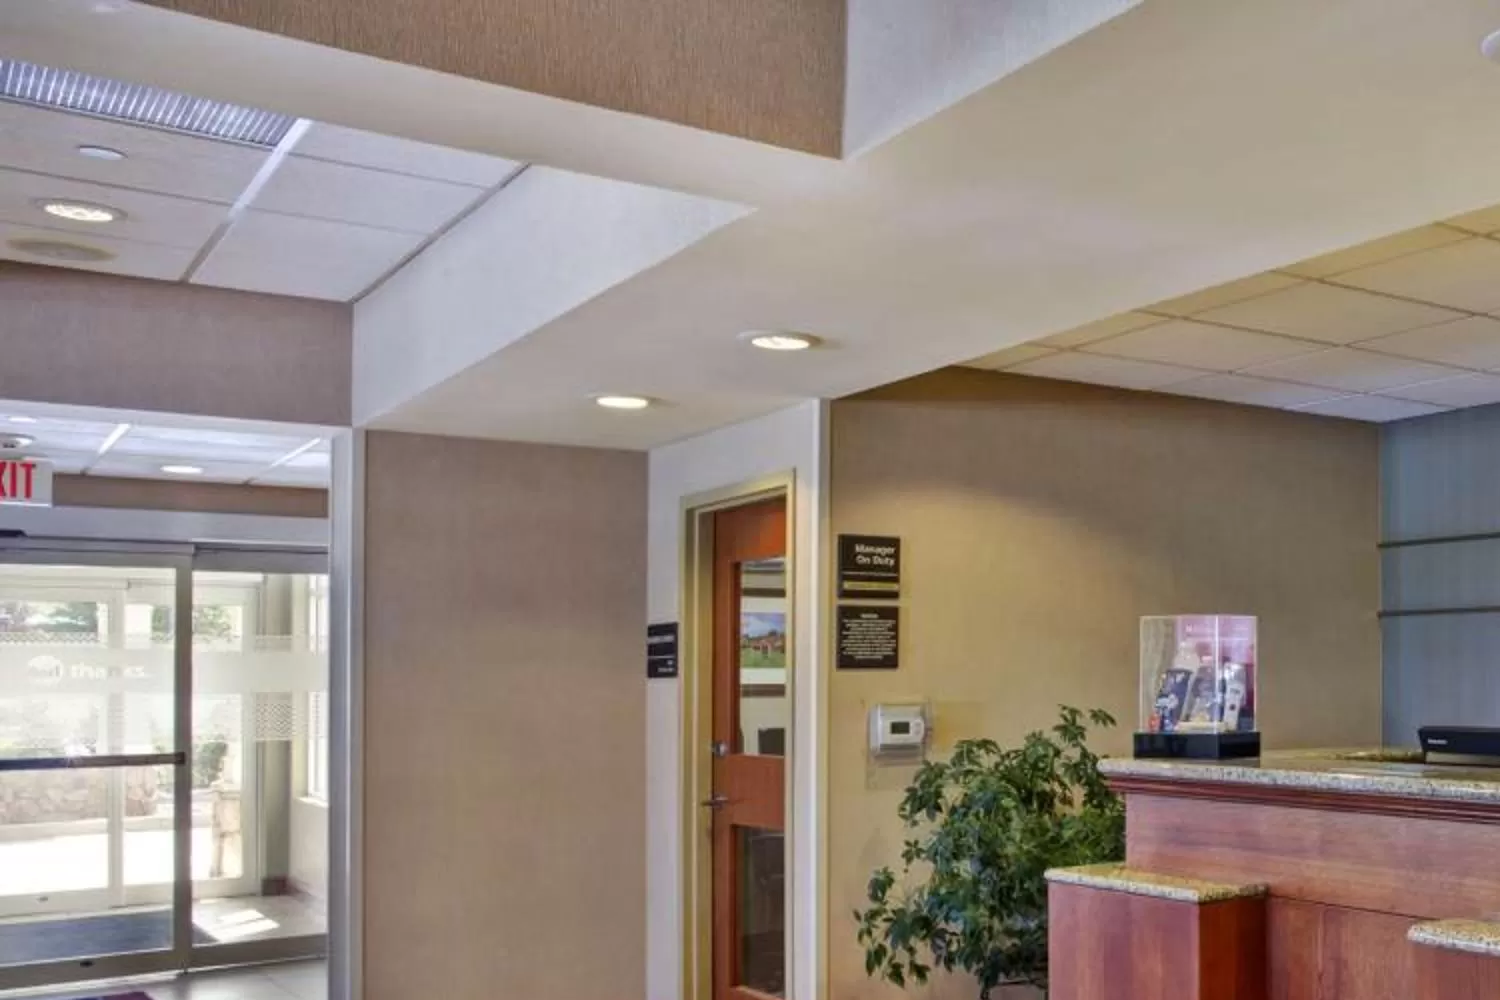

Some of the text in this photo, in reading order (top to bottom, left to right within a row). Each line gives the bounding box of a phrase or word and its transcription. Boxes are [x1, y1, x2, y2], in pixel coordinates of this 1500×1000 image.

[855, 544, 896, 556] Manager
[856, 555, 895, 568] On Duty
